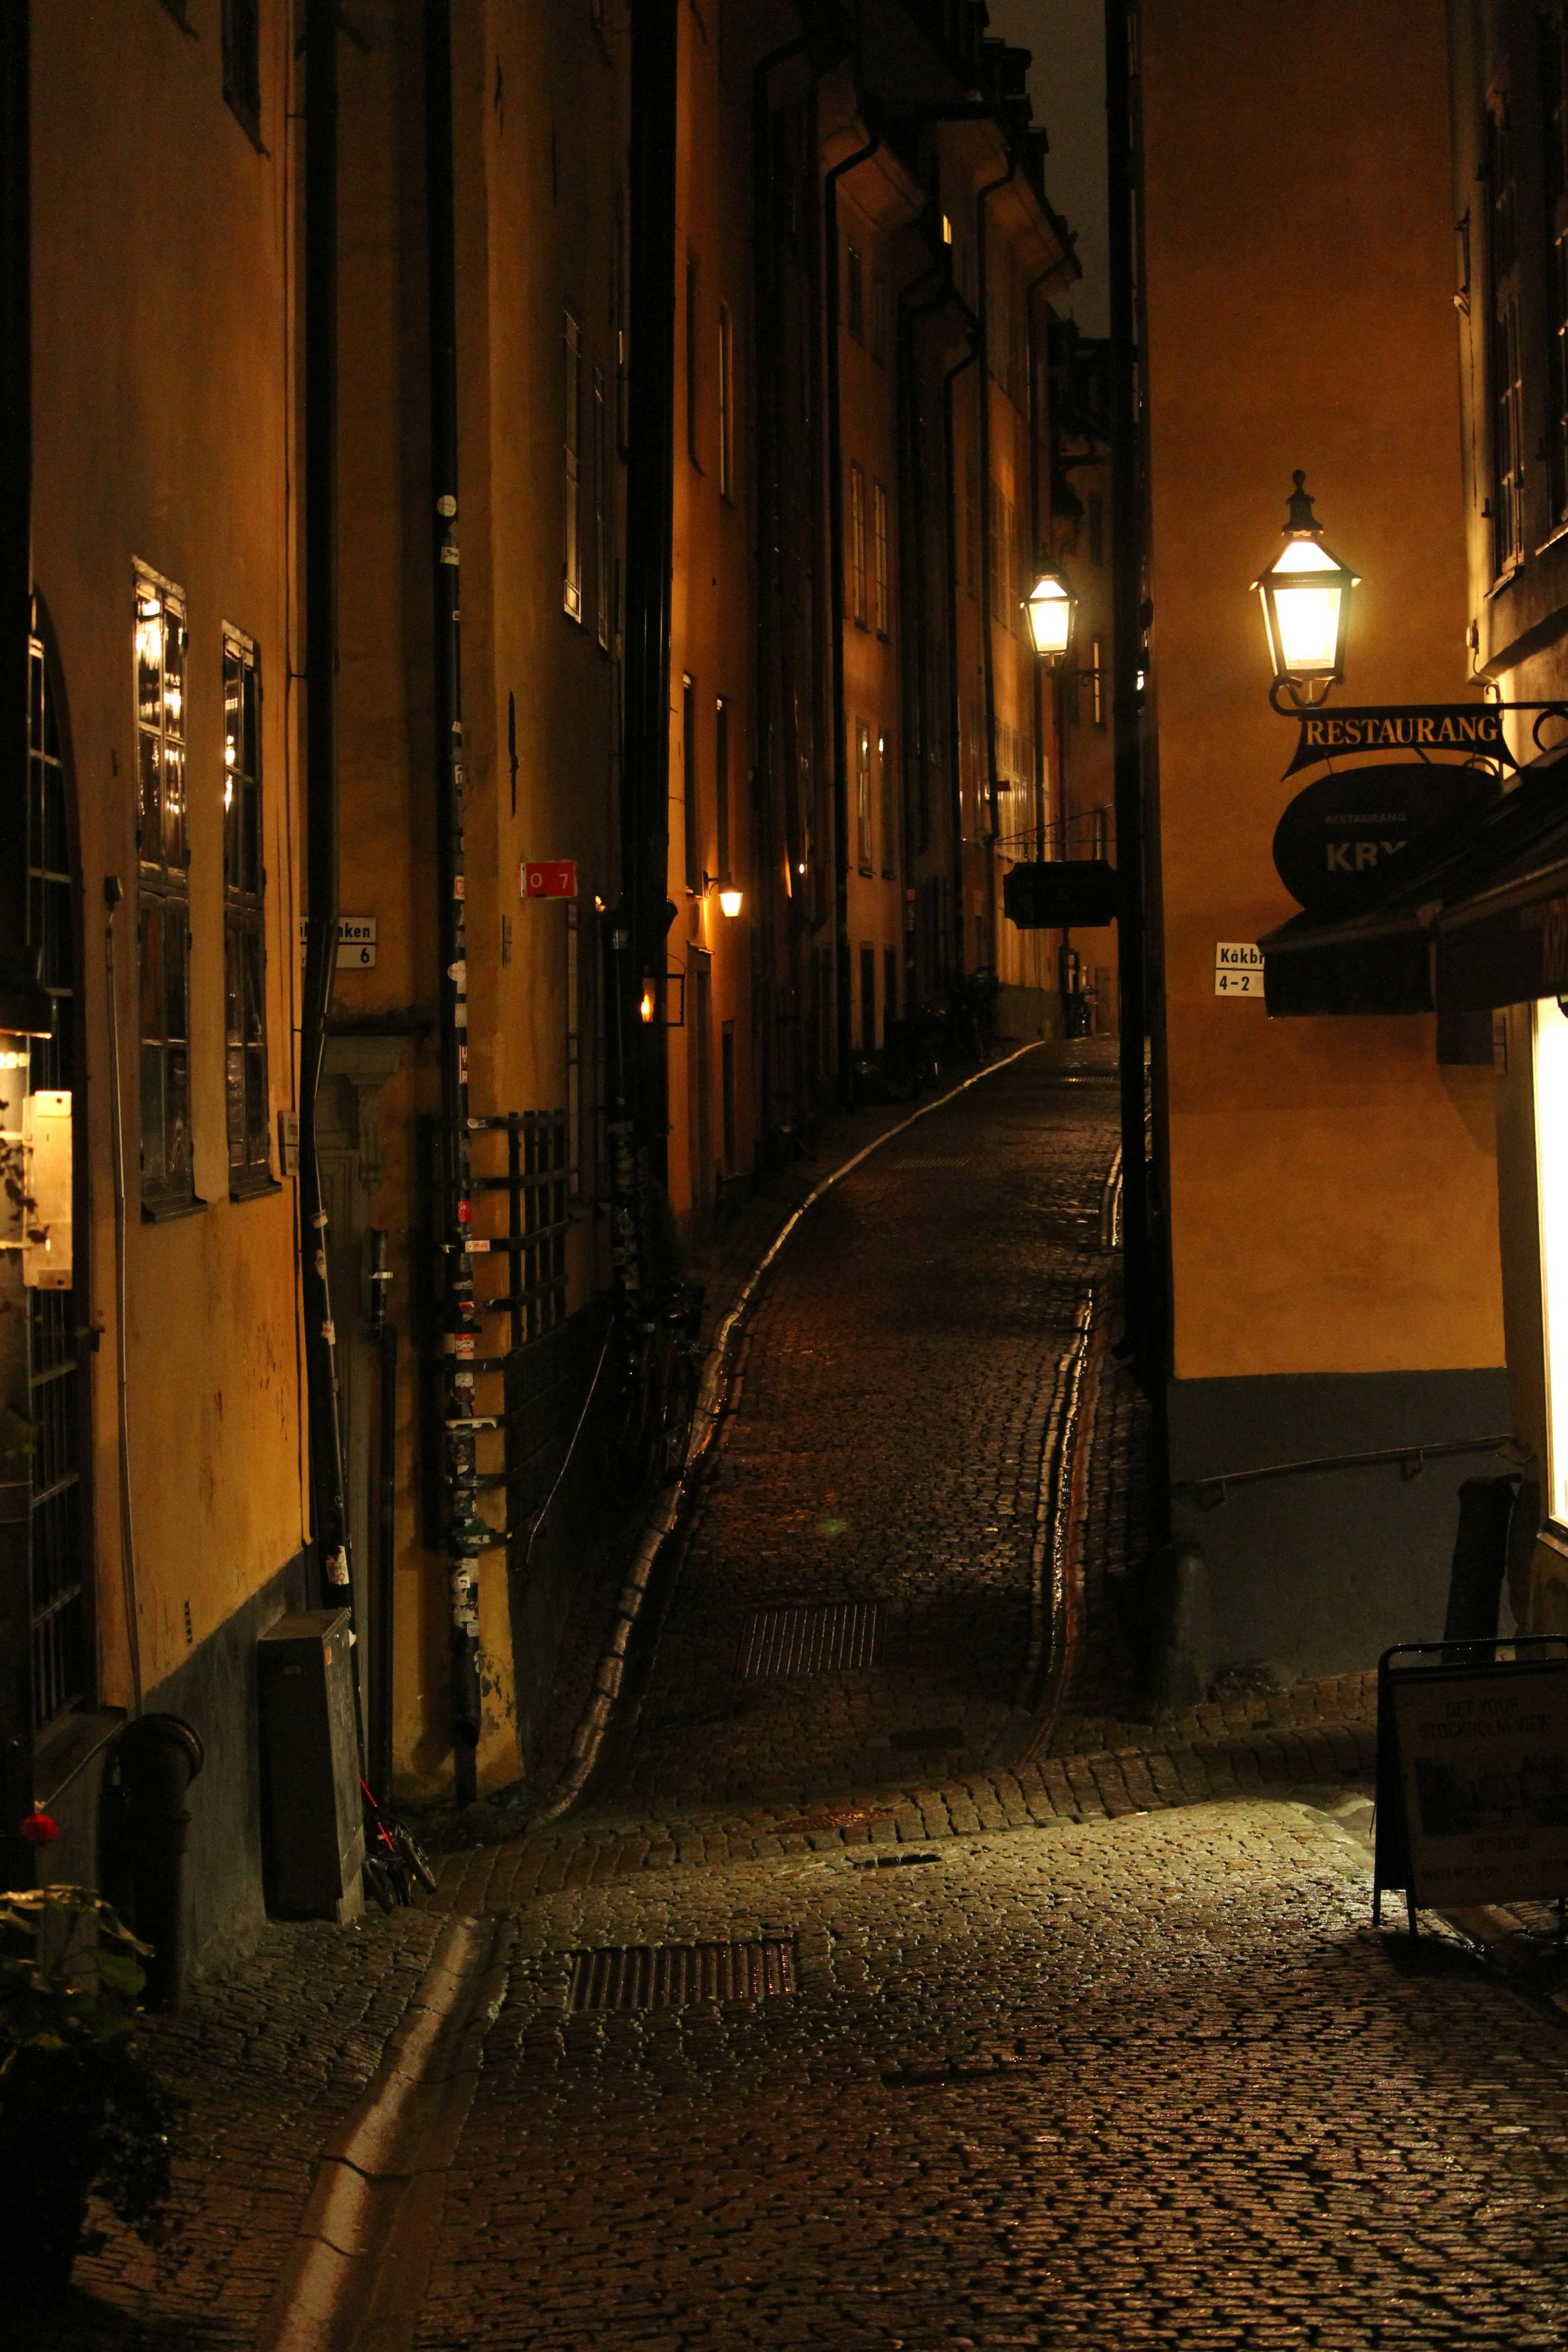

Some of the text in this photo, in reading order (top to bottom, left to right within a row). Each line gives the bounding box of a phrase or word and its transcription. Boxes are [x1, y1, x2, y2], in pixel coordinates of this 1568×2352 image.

[1306, 715, 1498, 745] RESTAURANG
[1325, 812, 1406, 824] RESTAURANG
[361, 947, 370, 963] 6
[1221, 948, 1265, 964] Kåkbr
